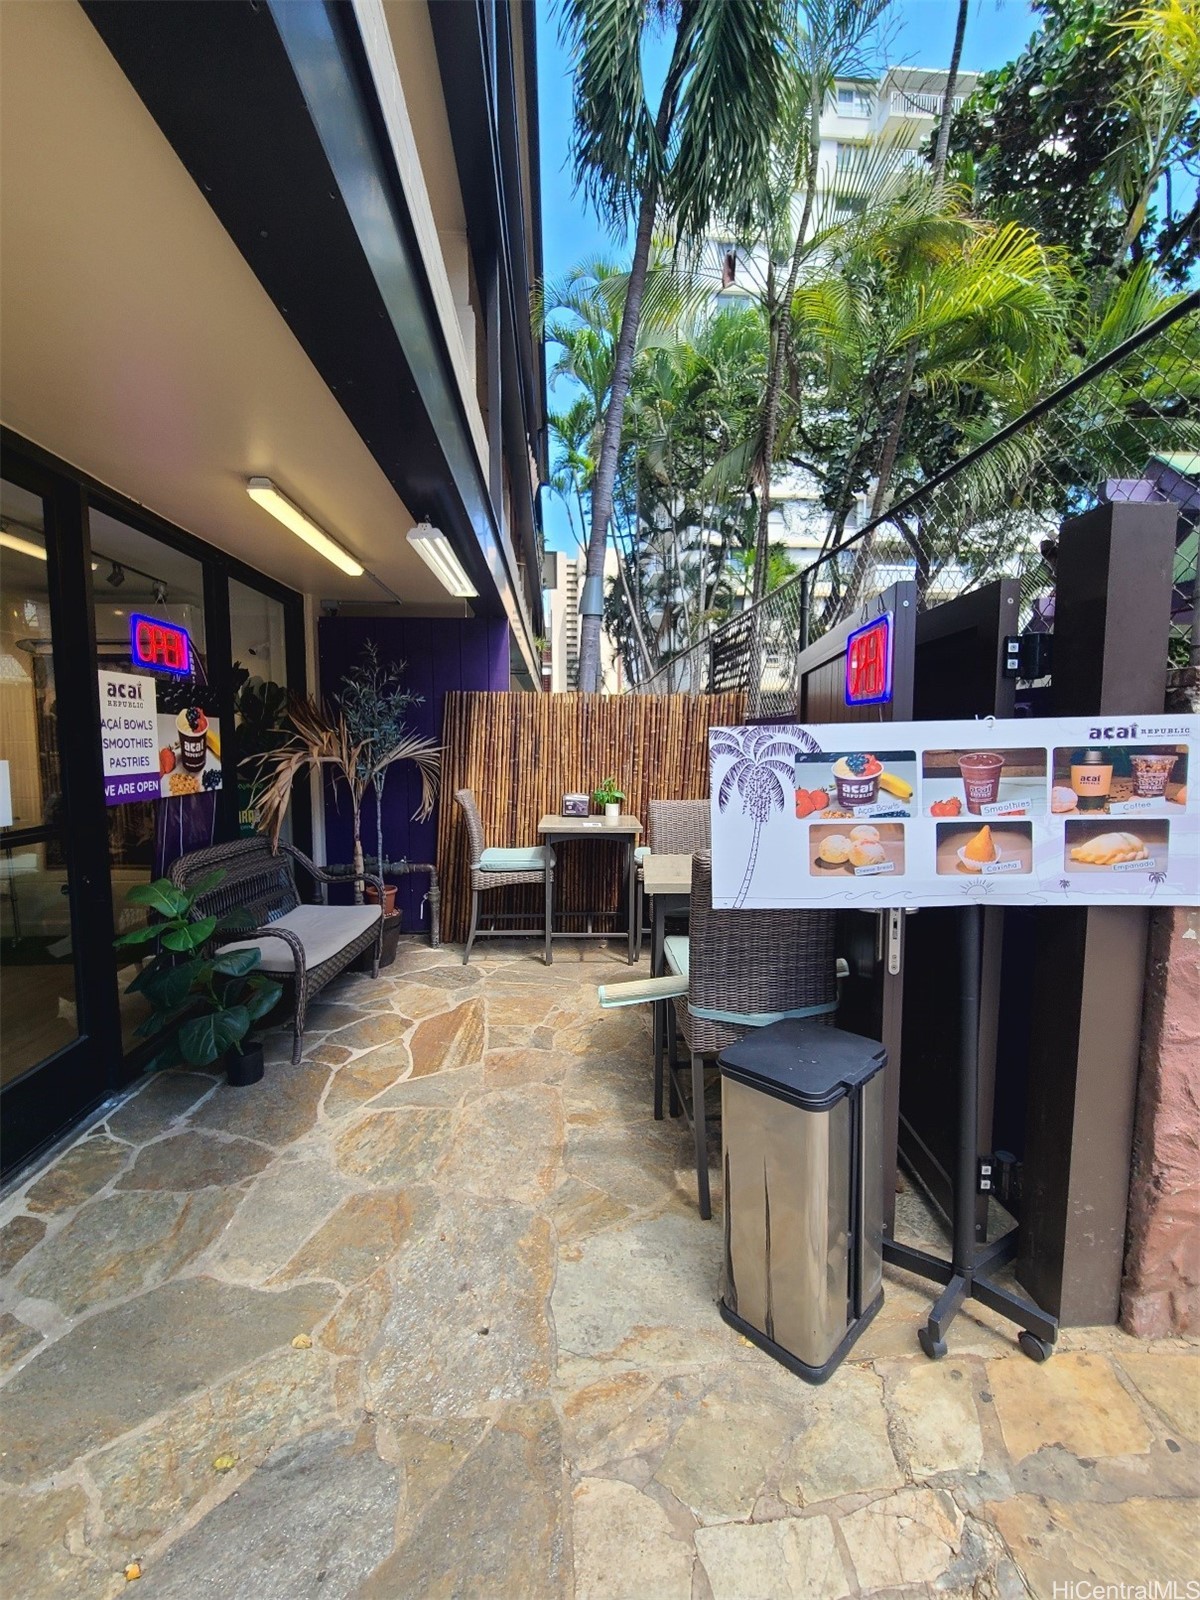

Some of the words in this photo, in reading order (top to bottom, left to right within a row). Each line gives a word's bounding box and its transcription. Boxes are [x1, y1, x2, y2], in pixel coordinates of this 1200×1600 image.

[107, 700, 144, 709] REPUBLIC
[124, 719, 153, 730] BOWLS
[103, 738, 153, 749] SMOOTHIES
[110, 756, 150, 768] PASTRIES
[117, 782, 135, 795] ARE
[137, 780, 159, 793] OPEN
[876, 802, 900, 812] Bowls
[984, 801, 1031, 814] Smoothies
[1123, 802, 1151, 811] Coffee
